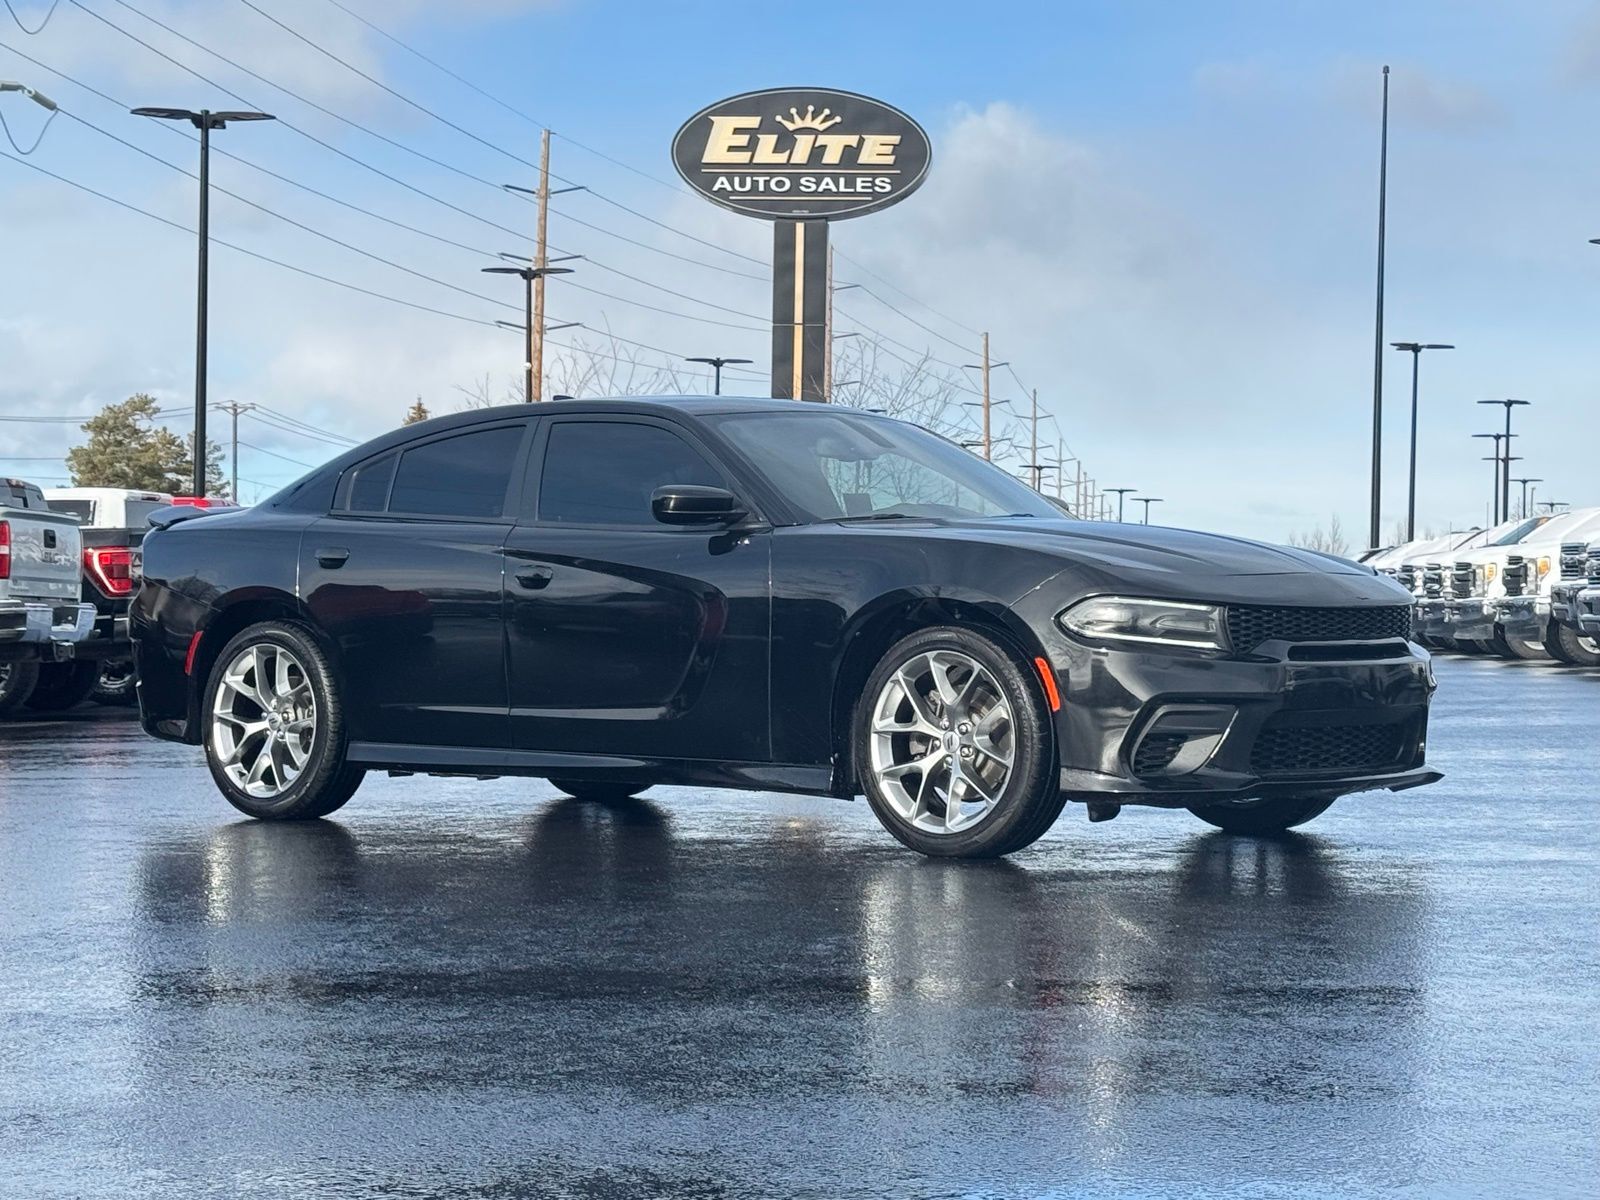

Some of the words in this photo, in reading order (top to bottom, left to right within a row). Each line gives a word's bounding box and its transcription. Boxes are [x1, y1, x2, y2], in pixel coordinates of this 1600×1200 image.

[701, 116, 901, 165] ELITE
[712, 176, 791, 192] AUTO
[799, 176, 892, 192] SALES
